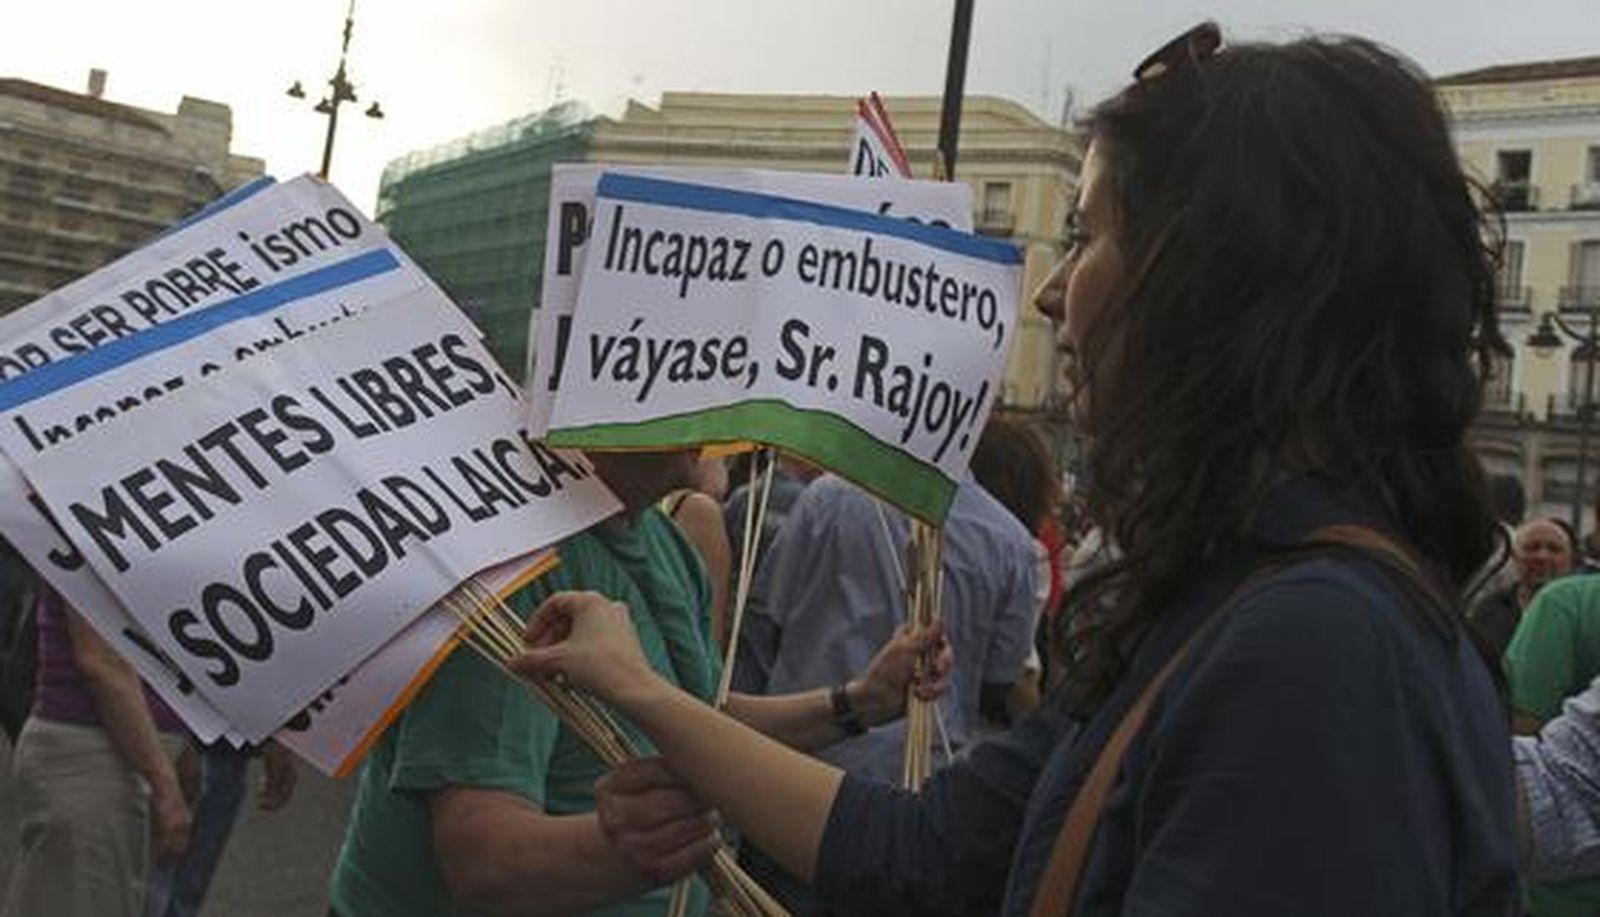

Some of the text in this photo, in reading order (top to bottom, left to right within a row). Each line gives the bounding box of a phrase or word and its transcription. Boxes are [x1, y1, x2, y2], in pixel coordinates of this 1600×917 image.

[604, 204, 752, 298] Incapaz
[761, 239, 785, 277] o
[797, 238, 1004, 348] embustero,
[69, 395, 334, 574] MENTES
[309, 334, 517, 439] LIBRES,
[590, 318, 759, 403] váyase,
[775, 319, 838, 391] Sr.
[853, 335, 989, 464] Rajoy!
[167, 476, 451, 689] SOCIEDAD
